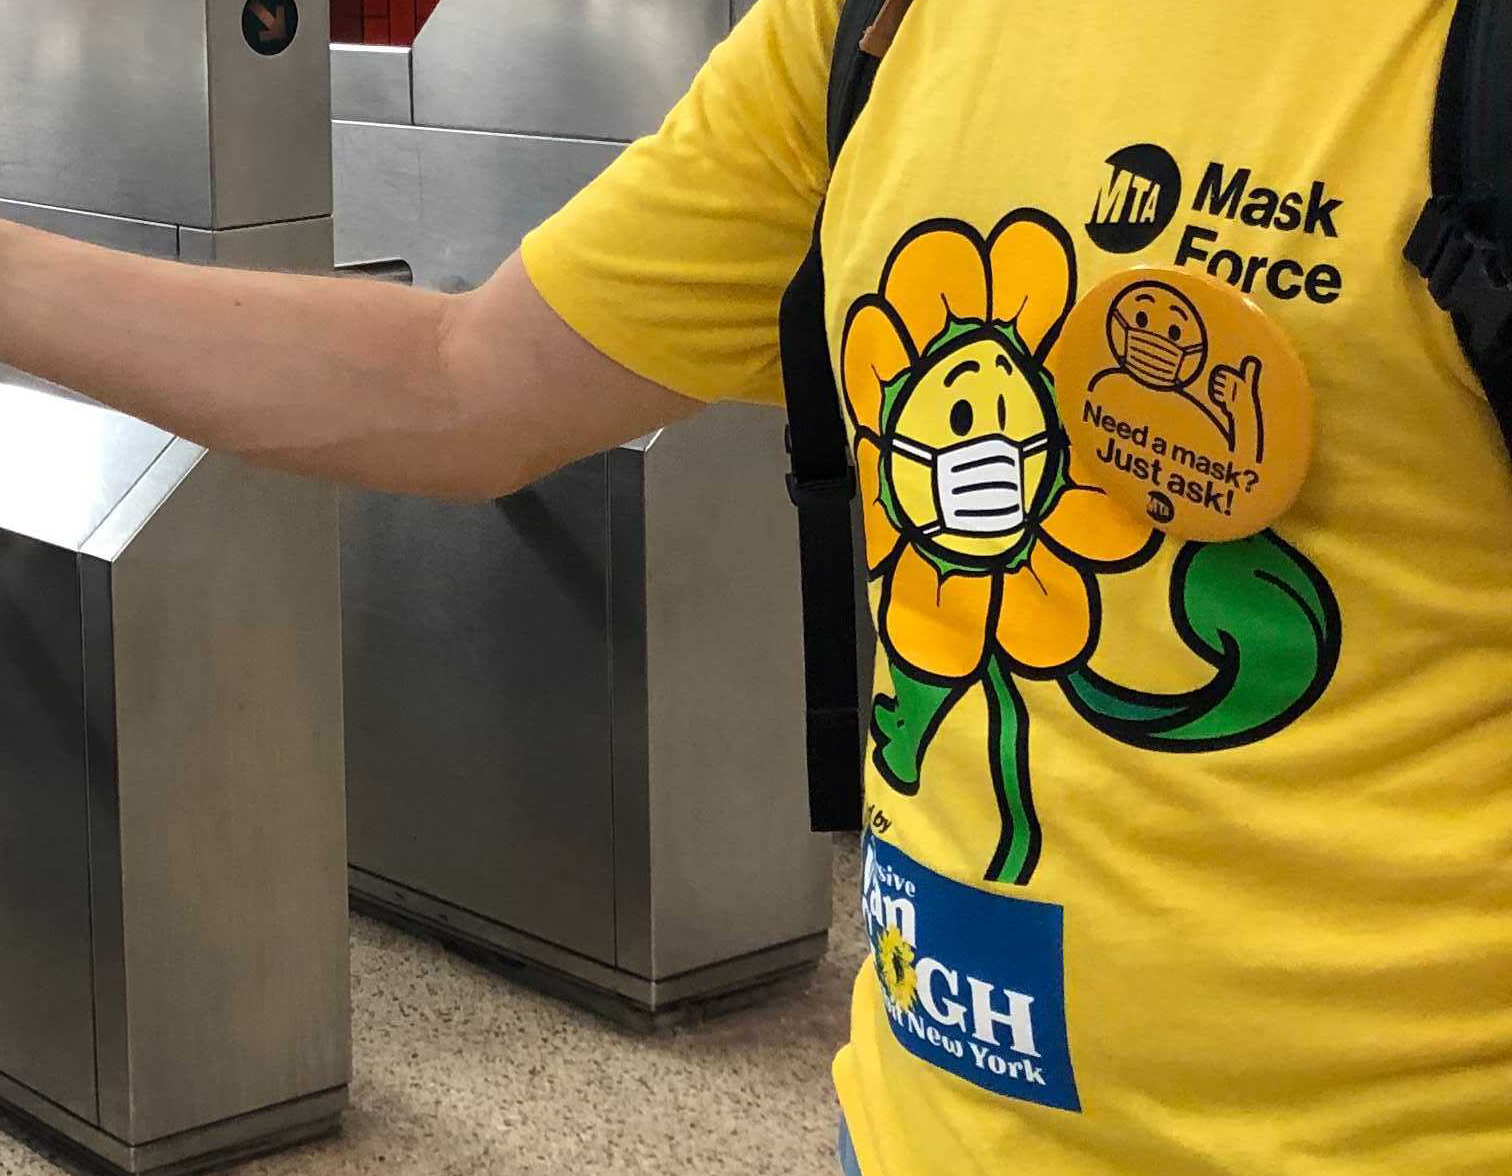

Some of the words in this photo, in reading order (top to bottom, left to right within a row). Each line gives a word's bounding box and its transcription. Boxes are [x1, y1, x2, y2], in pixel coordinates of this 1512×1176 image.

[1191, 162, 1344, 238] Mask
[1174, 224, 1342, 304] Force
[1083, 400, 1148, 448] Need
[1152, 437, 1167, 456] a
[1171, 444, 1260, 493] mask?
[1096, 438, 1162, 486] Just
[1167, 472, 1234, 516] ask!
[873, 810, 892, 833] by
[908, 1009, 963, 1058] New
[967, 1041, 1046, 1085] York
